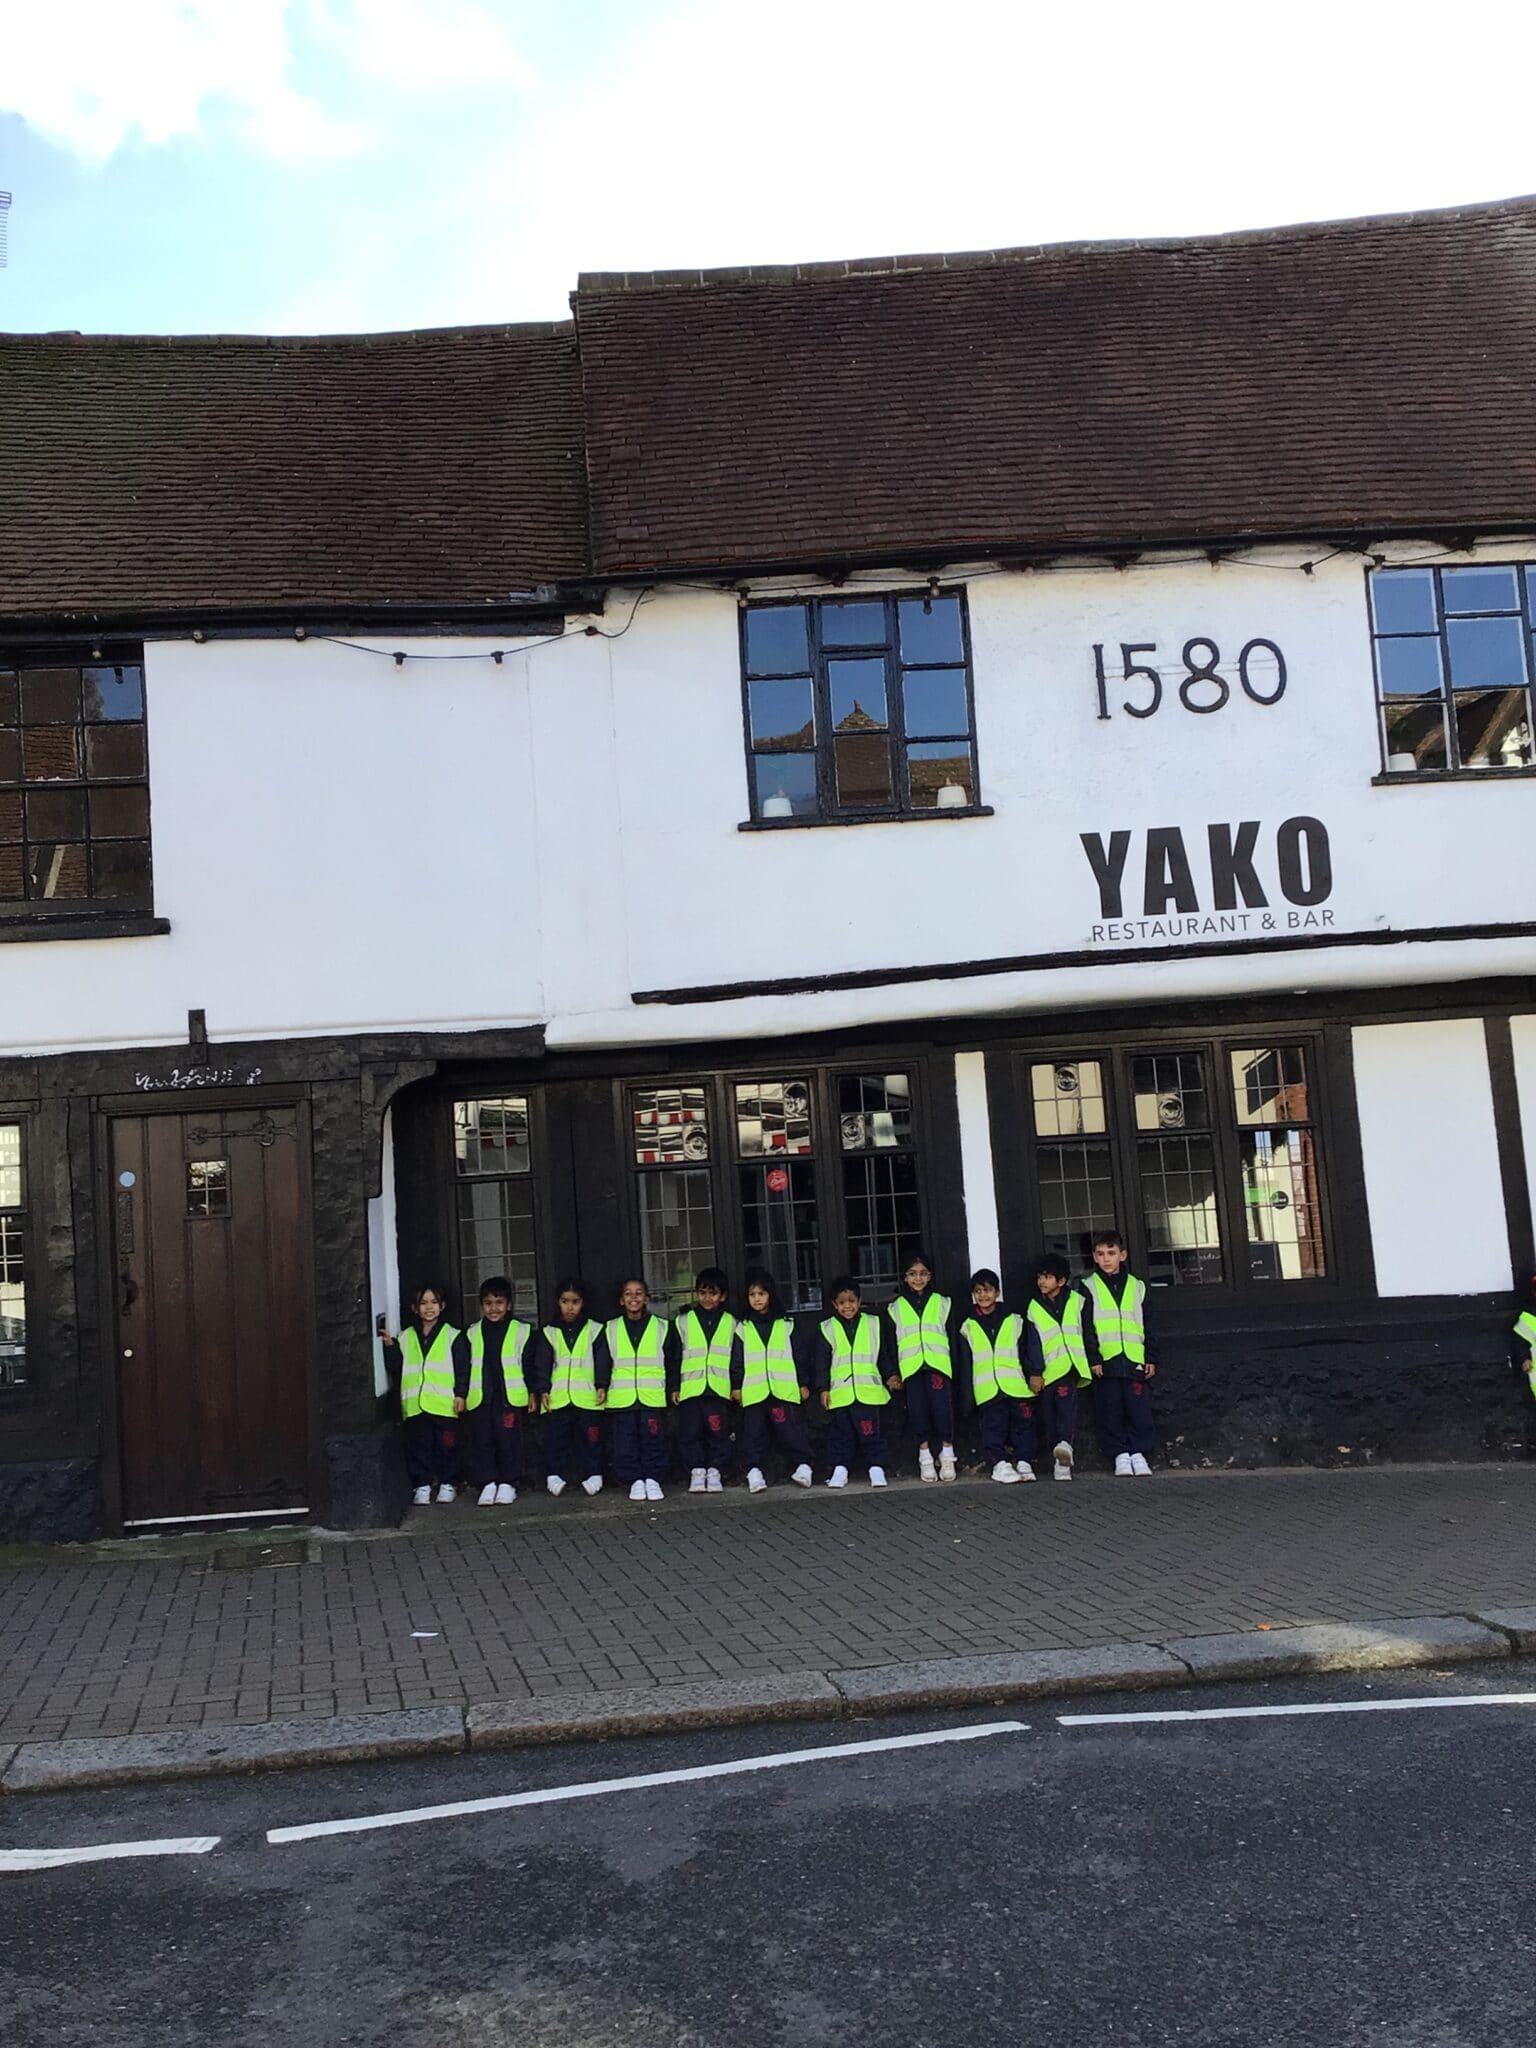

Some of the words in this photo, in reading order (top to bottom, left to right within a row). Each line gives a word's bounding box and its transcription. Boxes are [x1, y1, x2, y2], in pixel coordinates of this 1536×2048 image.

[1092, 637, 1287, 720] 1580
[1079, 816, 1333, 919] YAKO
[1092, 914, 1251, 942] RESTAURANT
[1261, 912, 1277, 930] &
[1287, 909, 1335, 929] BAR
